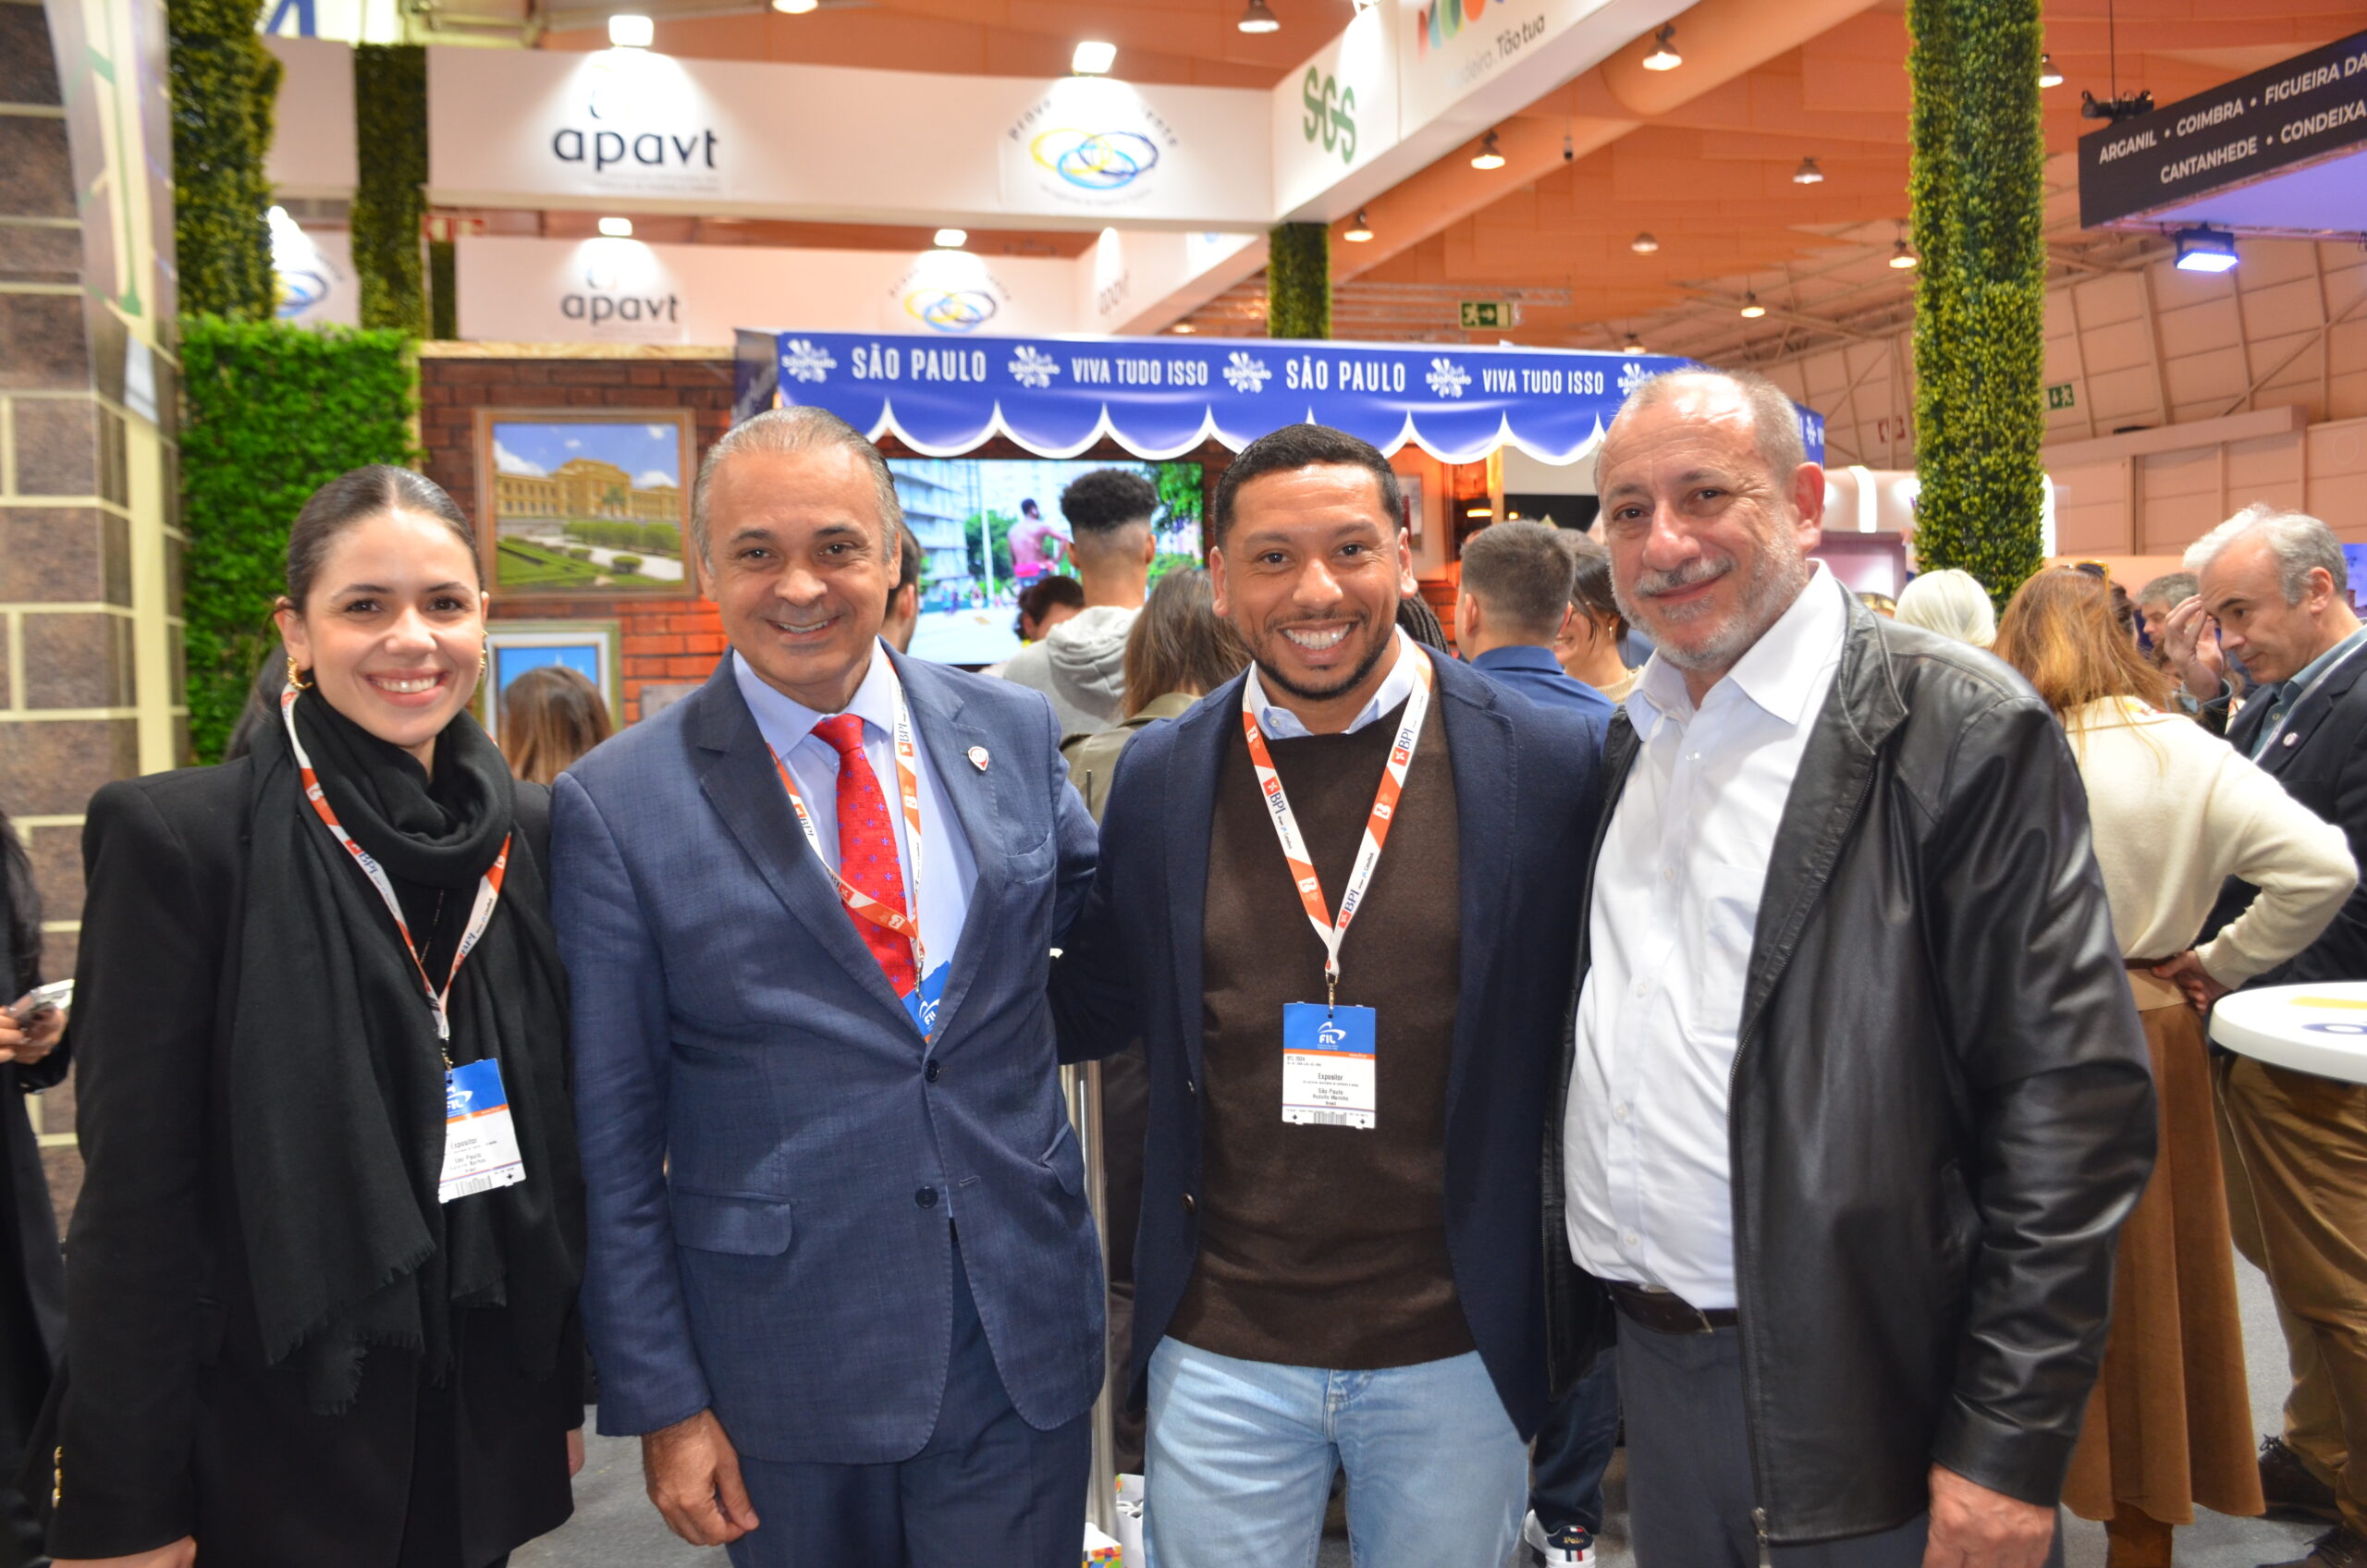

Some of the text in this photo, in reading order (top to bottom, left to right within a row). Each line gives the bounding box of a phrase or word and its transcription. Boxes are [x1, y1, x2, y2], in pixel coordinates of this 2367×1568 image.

[1303, 65, 1356, 165] SGS
[2099, 52, 2367, 165] ARGANIL COIMBRA FIGUEIRA DA
[552, 128, 718, 173] apavt
[2160, 99, 2367, 184] CANTANHEDE CONDEIXA
[560, 293, 680, 326] apavt
[851, 342, 901, 380] SÃO
[911, 349, 987, 382] PAULO
[1071, 357, 1111, 384] VIVA
[1115, 359, 1161, 386] TUDO
[1167, 360, 1208, 386] ISSO
[1285, 355, 1329, 390] SÃO
[1339, 361, 1406, 393] PAULO
[1482, 368, 1517, 394] VIVA
[1522, 368, 1563, 395] TUDO
[1567, 371, 1604, 396] ISSO
[898, 721, 910, 743] BPI
[1398, 727, 1414, 750] BPI
[1269, 791, 1286, 815] BPI
[358, 851, 378, 875] BPI
[1343, 888, 1359, 913] BPI
[1318, 1034, 1336, 1044] FIL
[1318, 1072, 1343, 1081] Expositor
